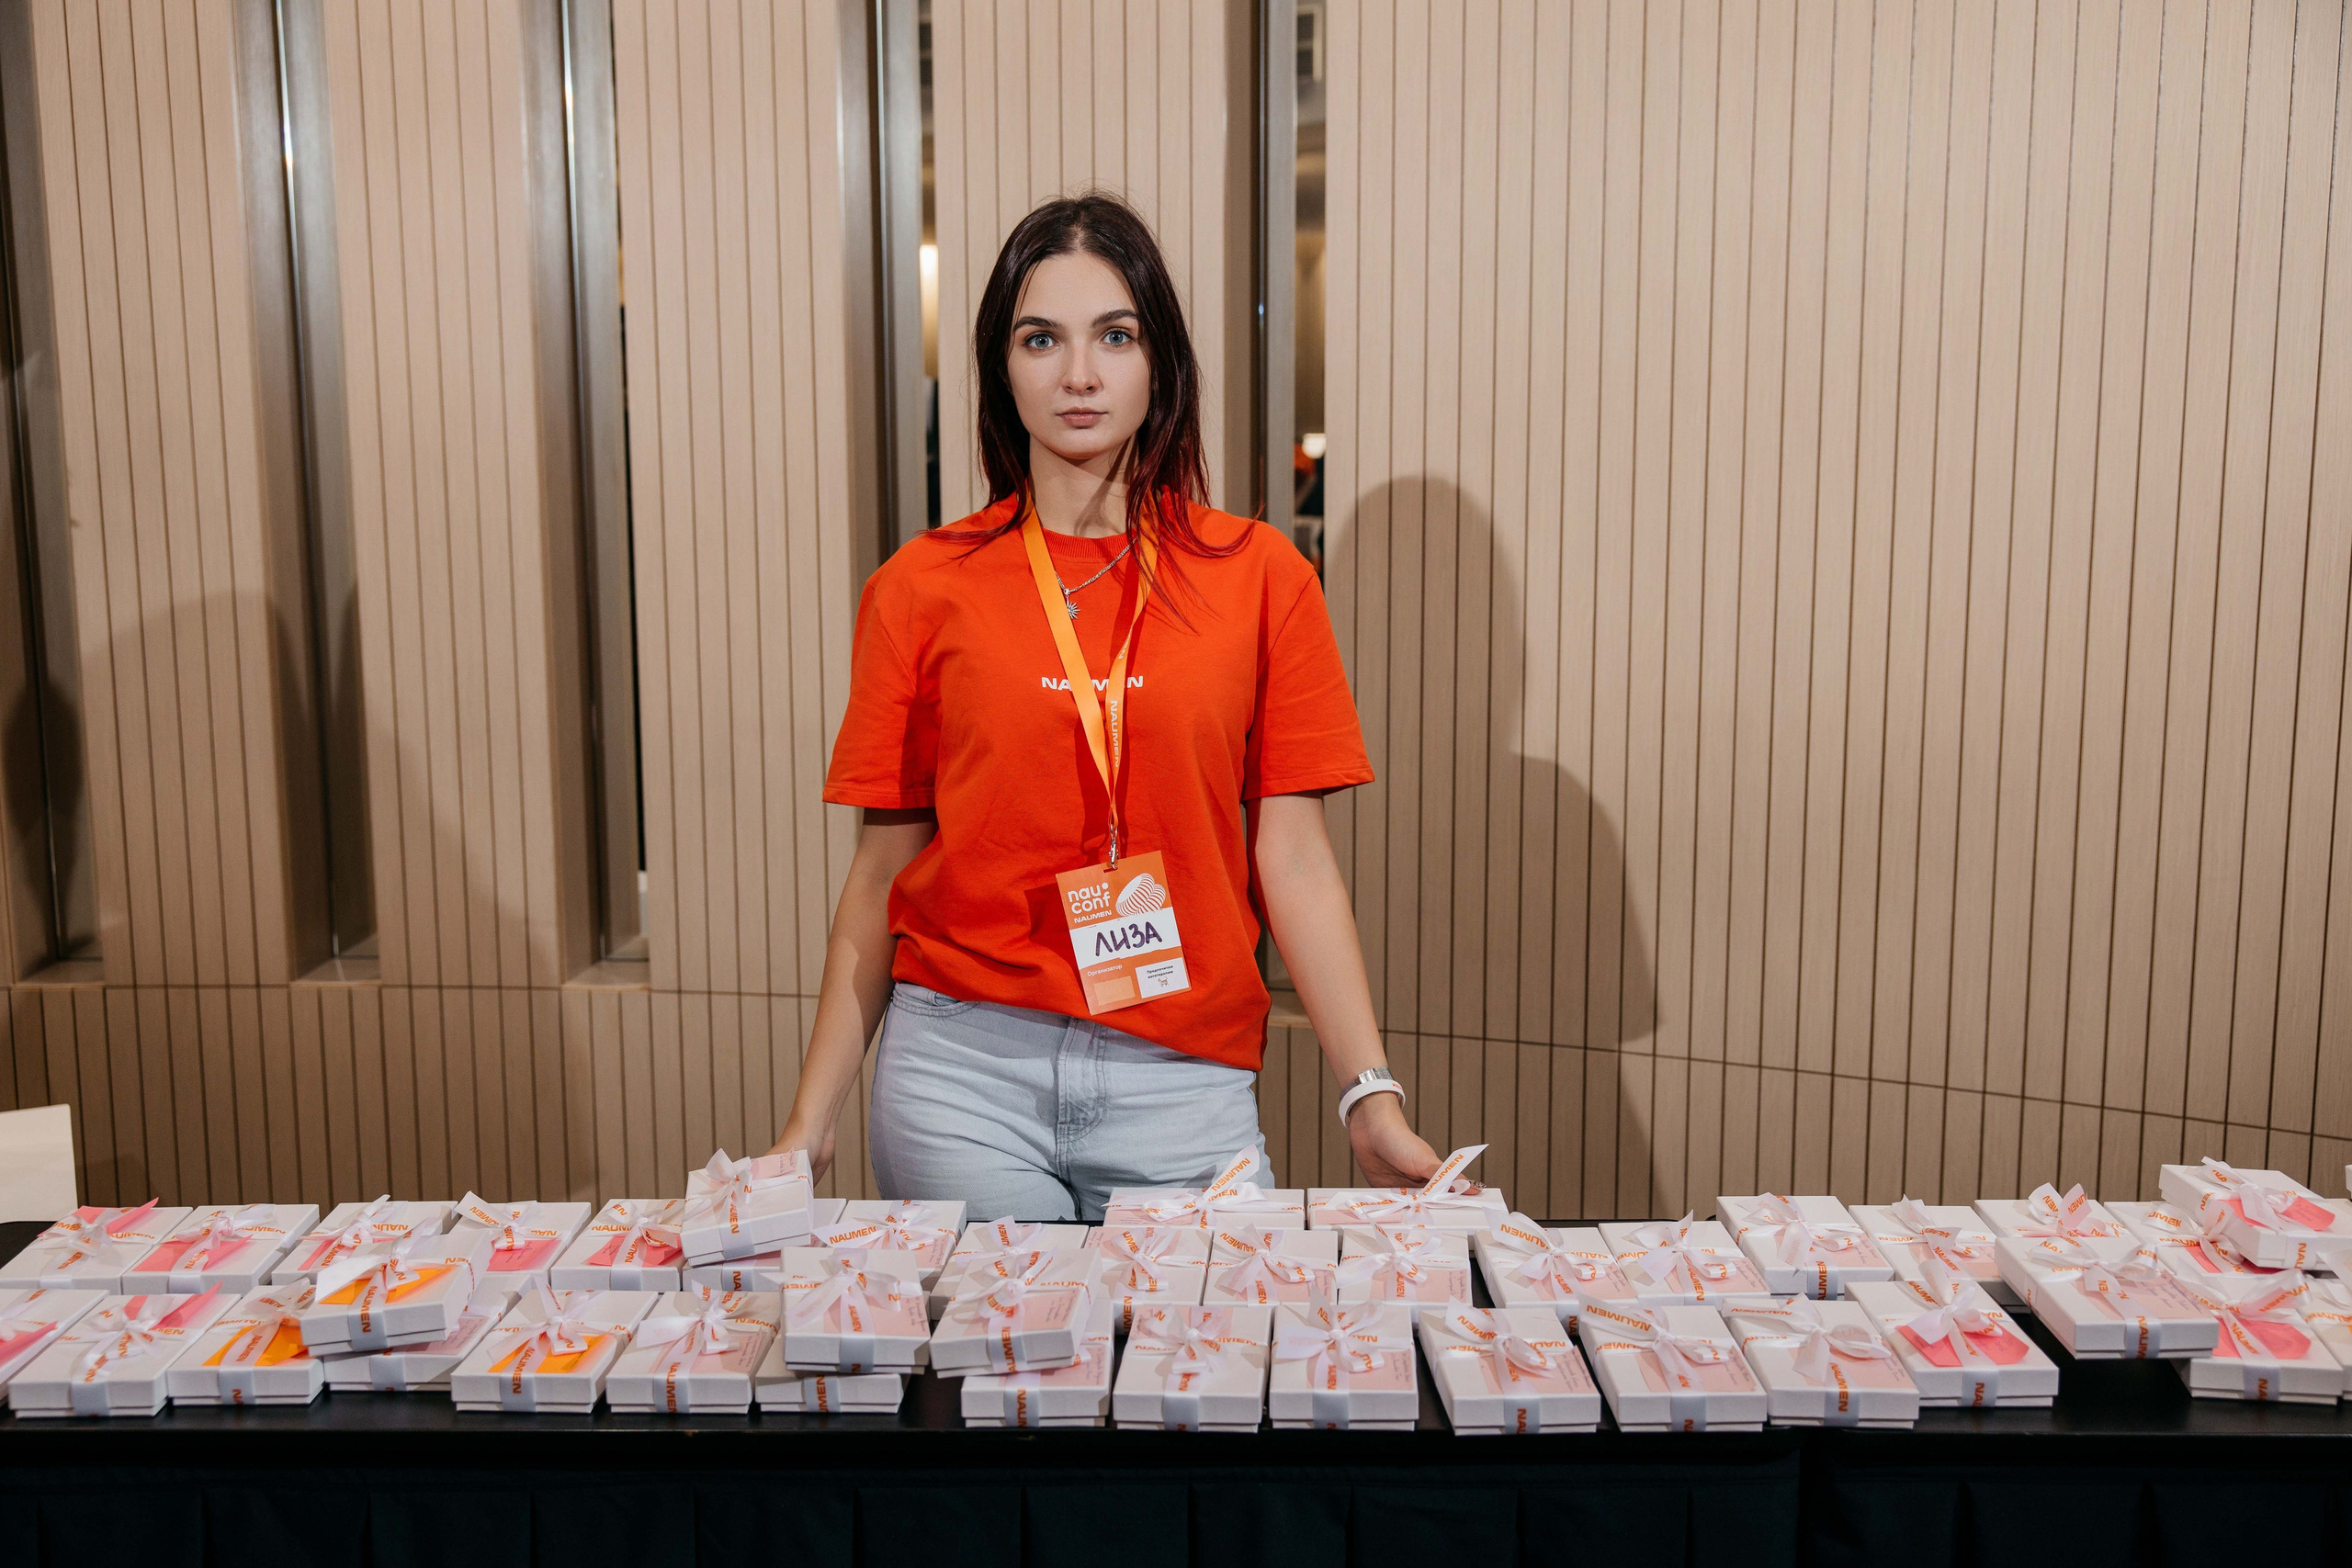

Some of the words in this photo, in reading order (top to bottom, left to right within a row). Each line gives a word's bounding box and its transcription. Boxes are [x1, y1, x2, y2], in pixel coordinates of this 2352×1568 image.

[1041, 675, 1144, 692] NAMN
[1110, 700, 1119, 768] NAUMEN
[1071, 892, 1111, 915] conf
[1073, 910, 1112, 924] NAUMEN
[1095, 921, 1163, 957] ЛИЗА
[1087, 964, 1123, 976] Организатор
[1213, 1157, 1250, 1191] NAUMEN
[1423, 1154, 1464, 1196] NAUMEN
[829, 1225, 876, 1244] NAUMEN
[1816, 1260, 1827, 1301] AUMEN
[360, 1285, 378, 1333] NAUMEN
[1586, 1304, 1651, 1332] NAUMEN
[1001, 1326, 1016, 1371] AUMEN
[2135, 1315, 2149, 1359] NAUM
[513, 1347, 535, 1394] NAUMEN
